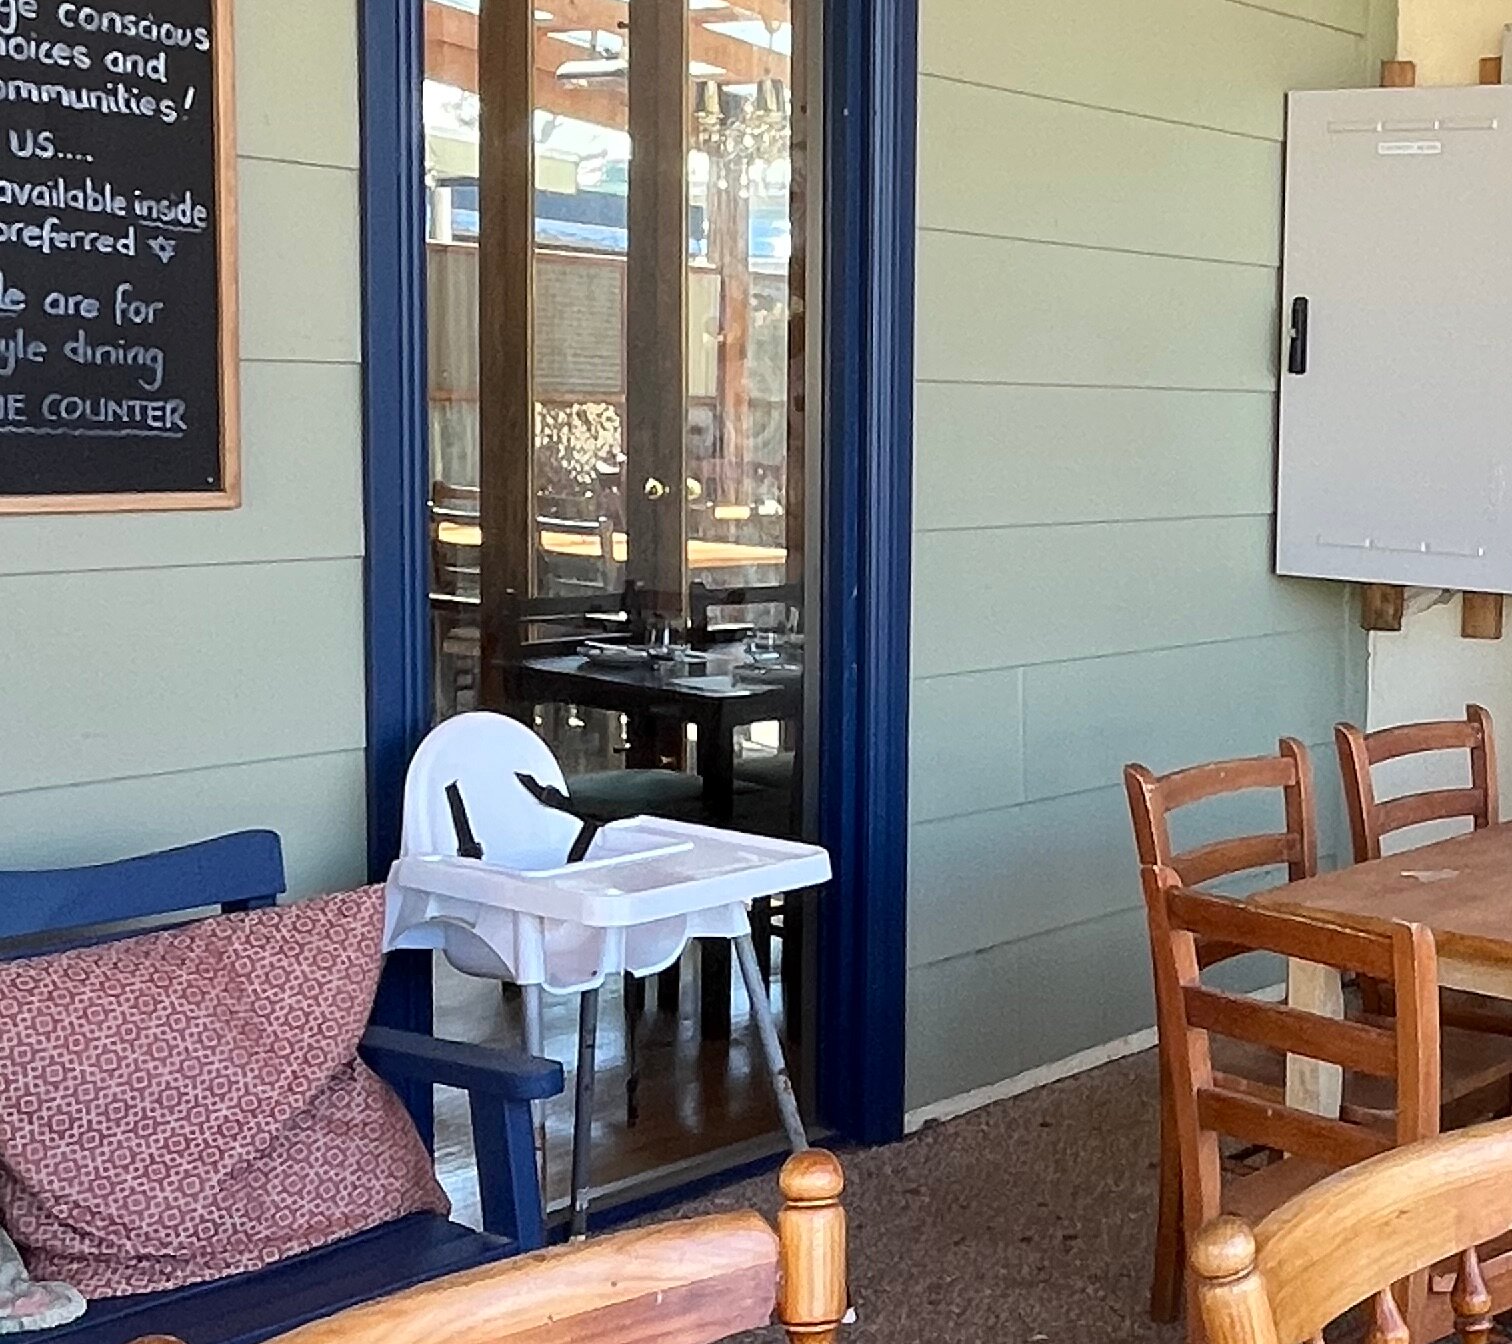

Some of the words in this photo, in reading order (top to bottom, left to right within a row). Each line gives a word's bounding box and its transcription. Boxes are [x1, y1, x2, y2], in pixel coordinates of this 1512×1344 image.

[58, 2, 210, 51] conscious
[104, 50, 168, 83] and
[0, 175, 127, 216] available
[134, 190, 208, 228] inside
[44, 292, 100, 319] are
[115, 282, 163, 325] for
[63, 329, 164, 391] dining
[41, 393, 187, 430] COUNTER
